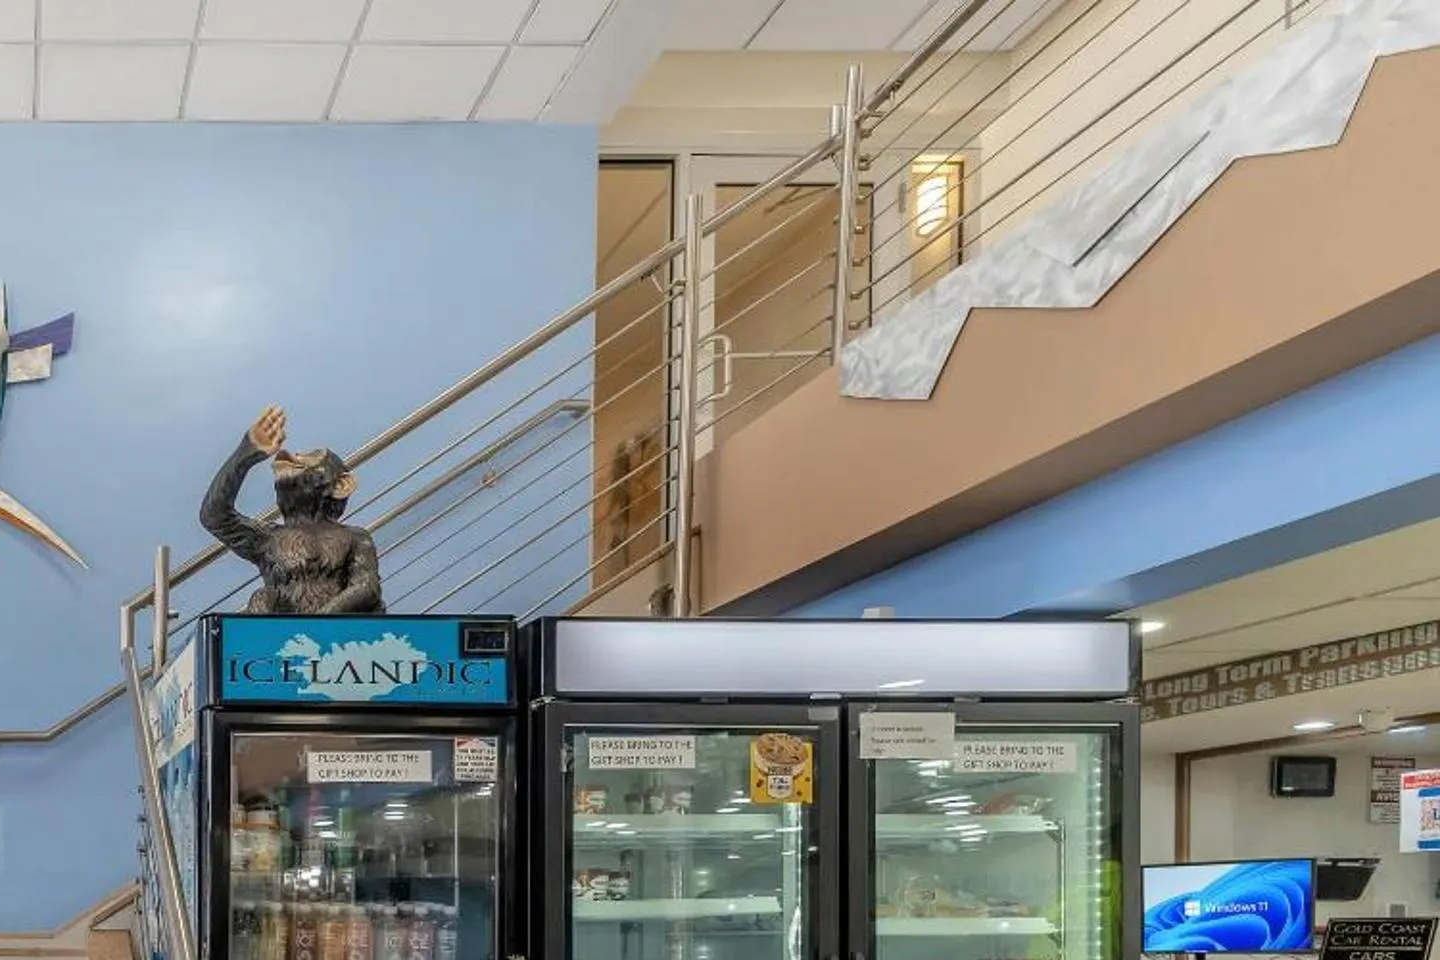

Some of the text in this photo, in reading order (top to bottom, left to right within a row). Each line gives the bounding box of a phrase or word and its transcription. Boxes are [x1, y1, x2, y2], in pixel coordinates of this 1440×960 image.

[228, 659, 491, 685] ICELANDIC
[1145, 672, 1208, 699] Long
[1216, 655, 1292, 685] Term
[1168, 686, 1249, 716] Tours
[1254, 681, 1277, 700] &
[659, 740, 673, 750] TO
[1031, 745, 1044, 755] TO
[318, 753, 352, 763] PLEASE
[1205, 901, 1269, 913] Windows 11
[1334, 922, 1427, 934] GOLD COAST
[1369, 935, 1424, 946] RENTAL
